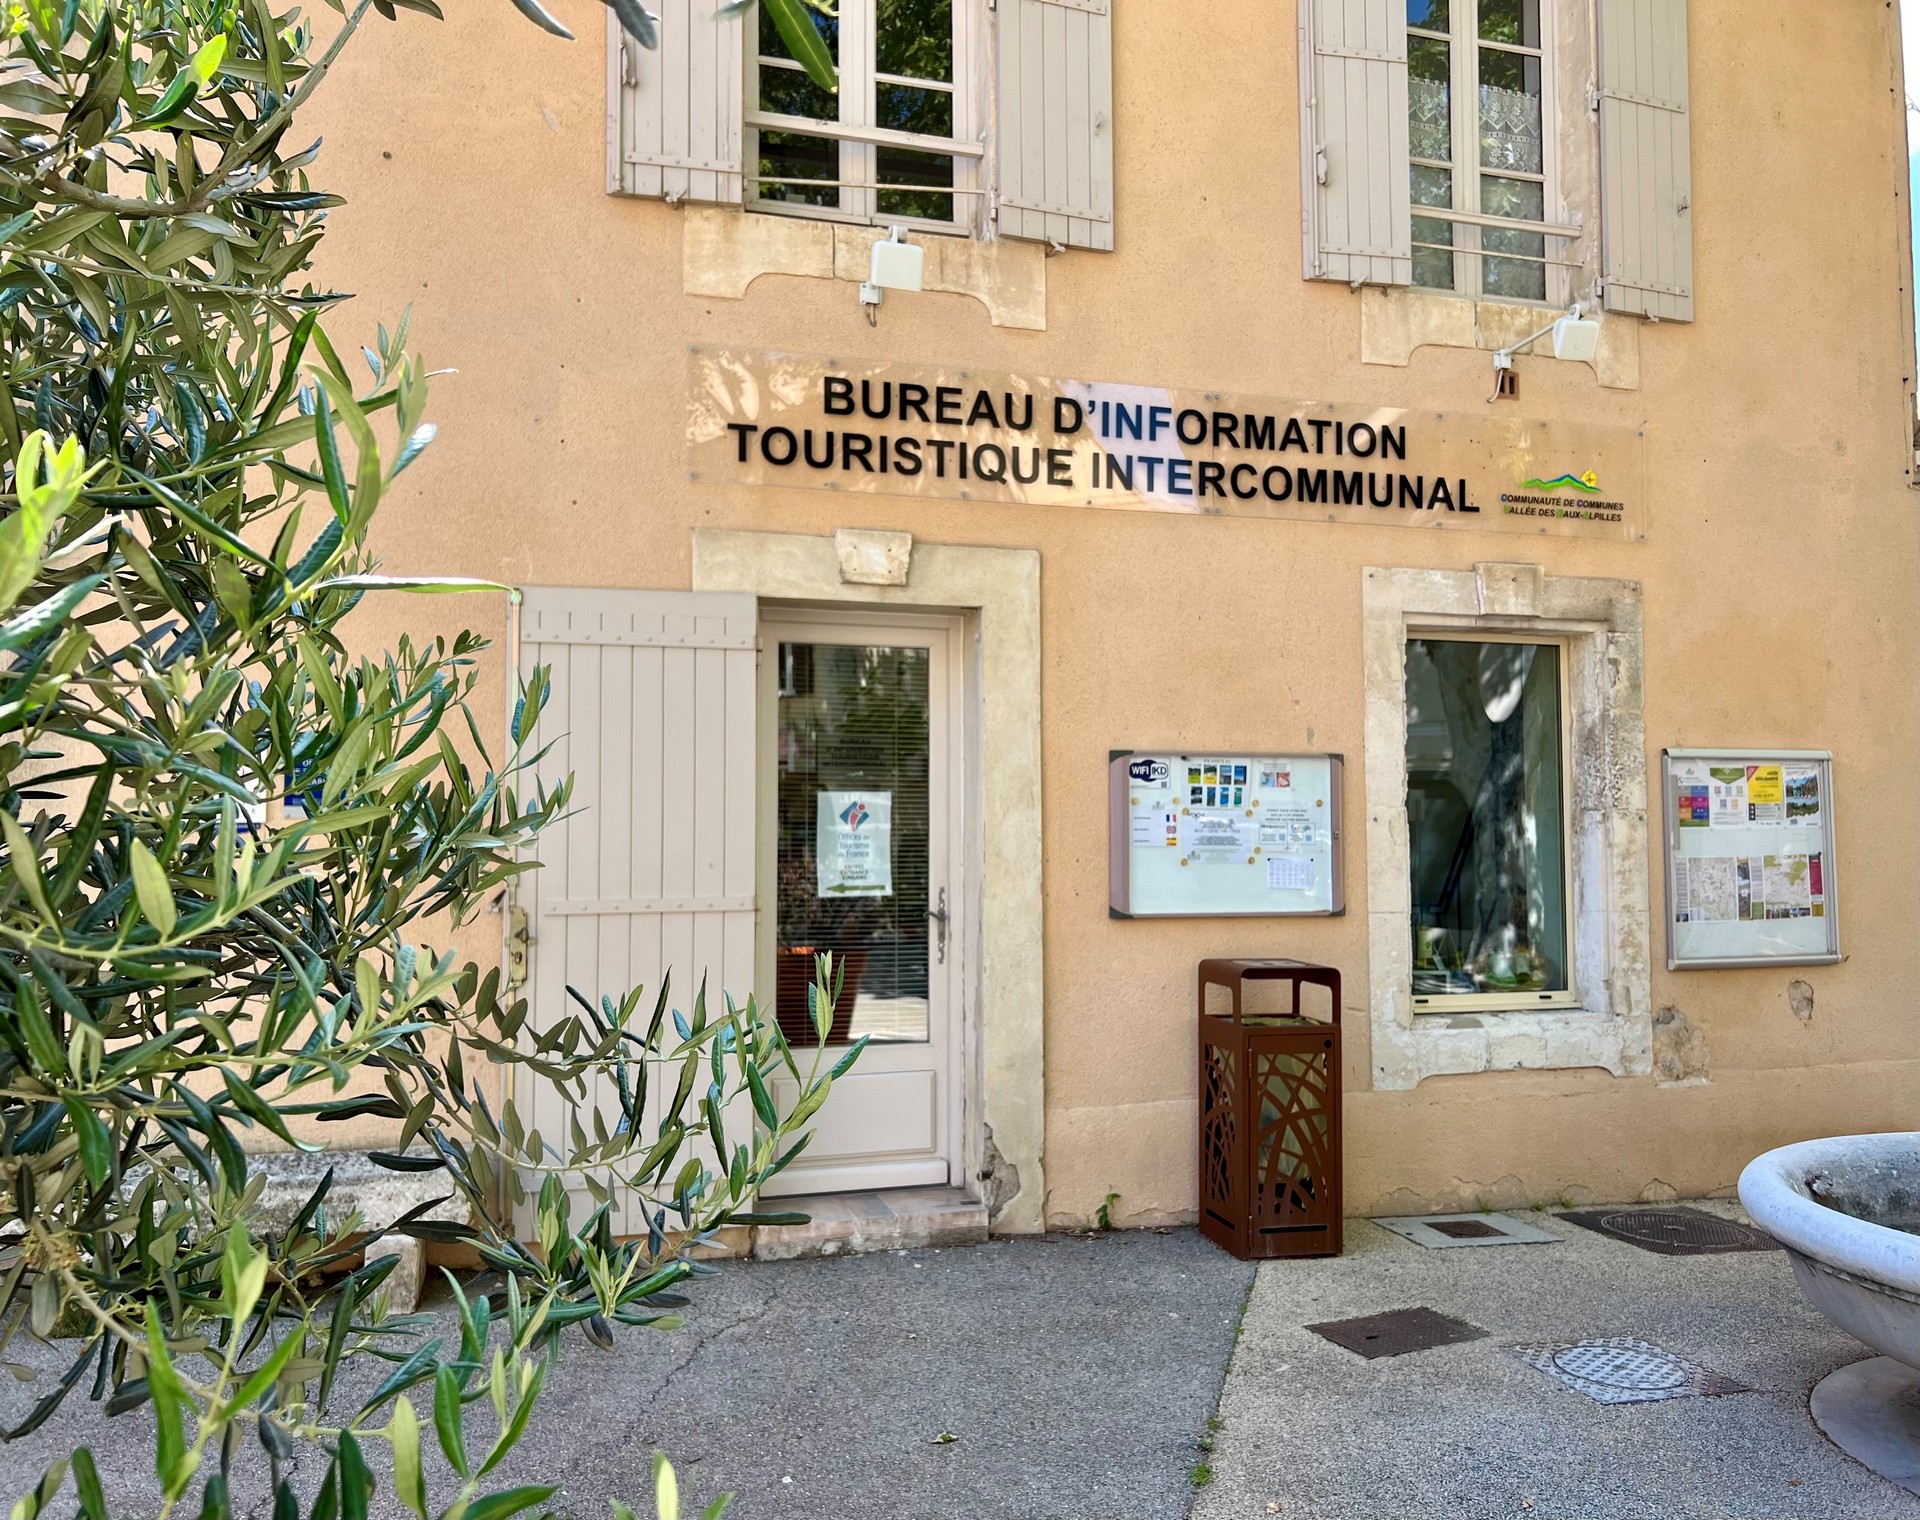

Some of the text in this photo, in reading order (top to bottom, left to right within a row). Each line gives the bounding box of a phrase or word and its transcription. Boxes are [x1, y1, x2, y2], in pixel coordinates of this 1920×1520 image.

[823, 375, 1406, 461] BUREAU D'INFORMATION
[727, 422, 1481, 514] TOURISTIQUE INTERCOMMUNAL
[1501, 493, 1624, 511] COMMUNAUTÉ DE COMMUNES
[1504, 505, 1622, 522] VALLÉE DES BAUX-ALPILLES
[839, 841, 870, 849] Tourisme
[846, 849, 870, 858] France
